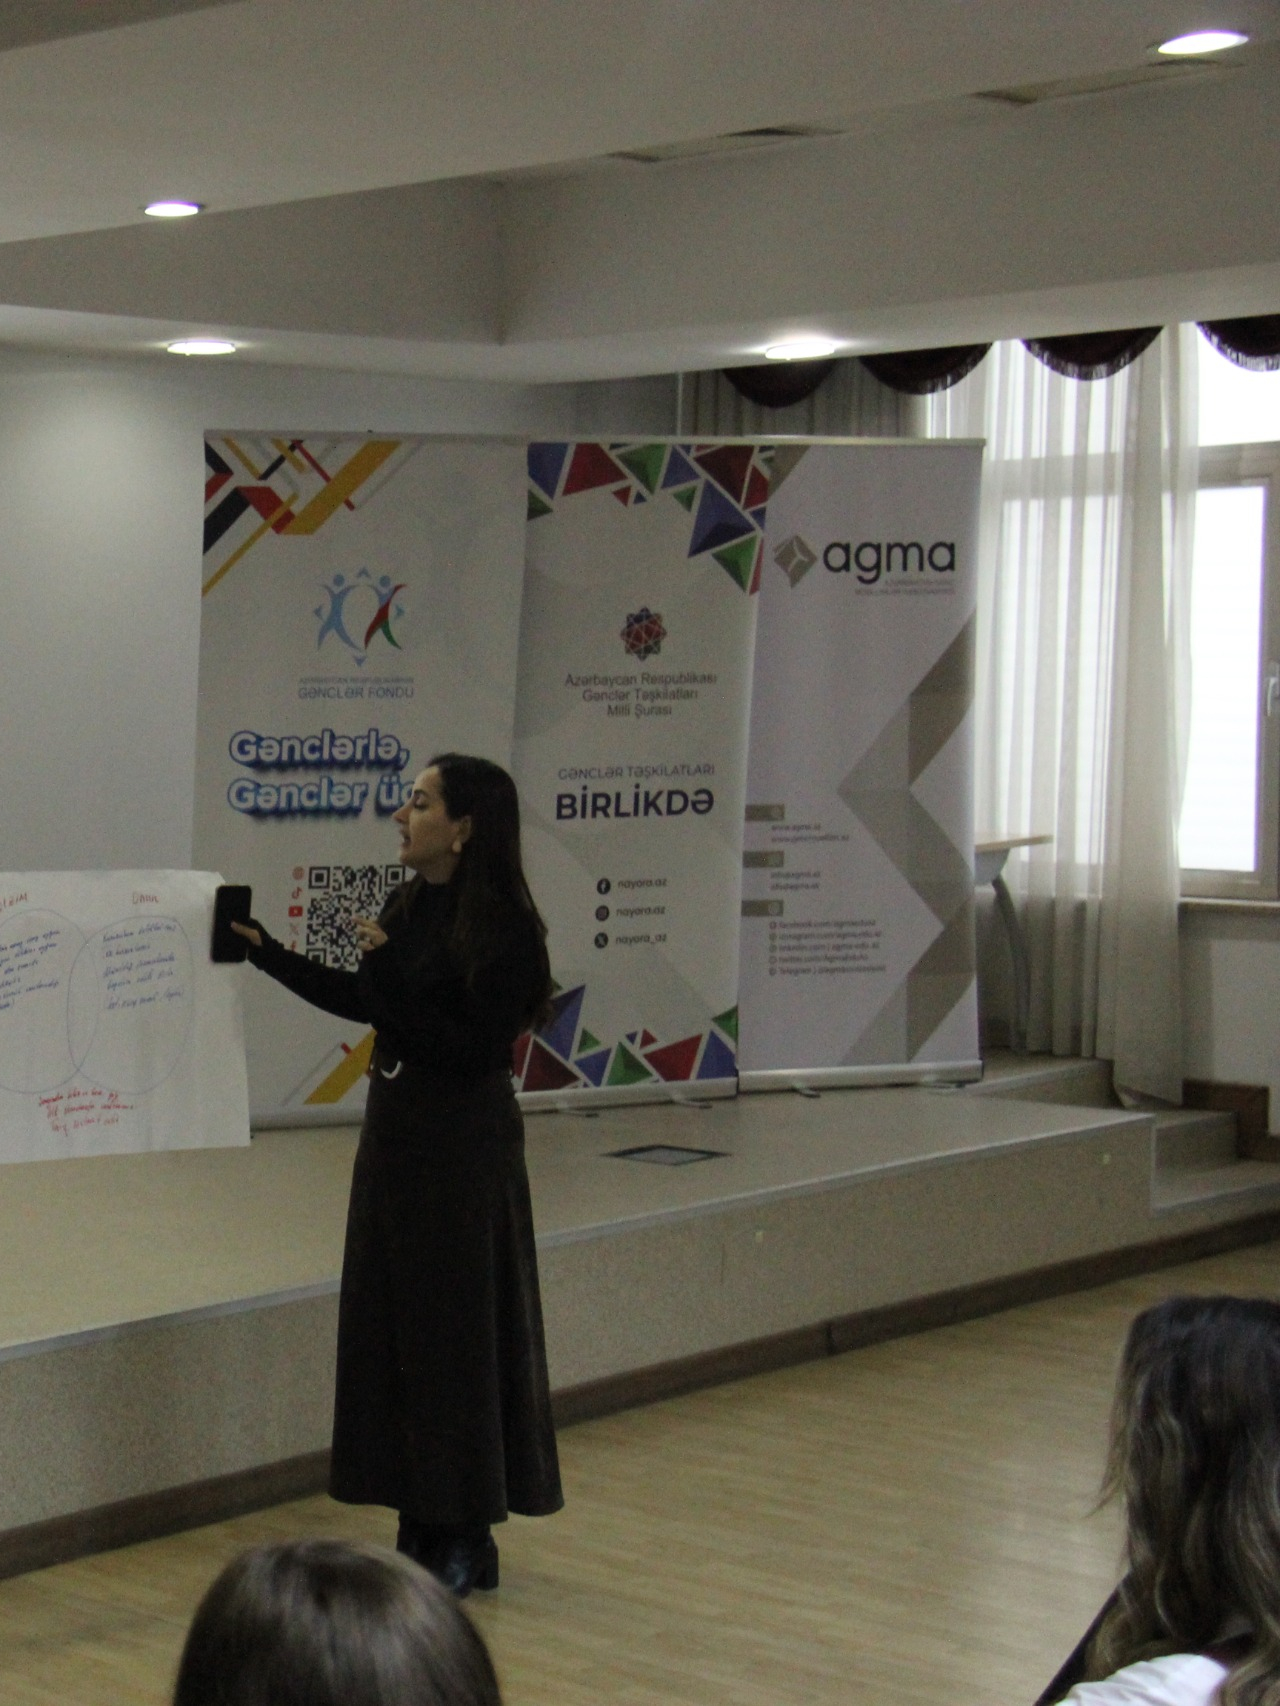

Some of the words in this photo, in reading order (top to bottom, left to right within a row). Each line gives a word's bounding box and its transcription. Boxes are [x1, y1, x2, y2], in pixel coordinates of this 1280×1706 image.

[823, 541, 956, 585] agma
[565, 674, 637, 688] Azərbaycan
[641, 672, 717, 688] Respublikası
[298, 686, 364, 699] GƏNCLƏR
[368, 686, 414, 699] FONDU
[582, 688, 630, 702] Gənclər
[635, 687, 698, 703] Təşkilatları
[608, 704, 630, 717] Milli
[635, 703, 672, 719] Şurası
[229, 728, 412, 772] Gənclərlə,
[558, 767, 623, 780] GƏNCLƏR
[228, 774, 369, 818] Gənclər
[556, 783, 714, 820] BİRLİKDƏ
[618, 878, 667, 889] nayora.az
[616, 907, 666, 917] nayora.az
